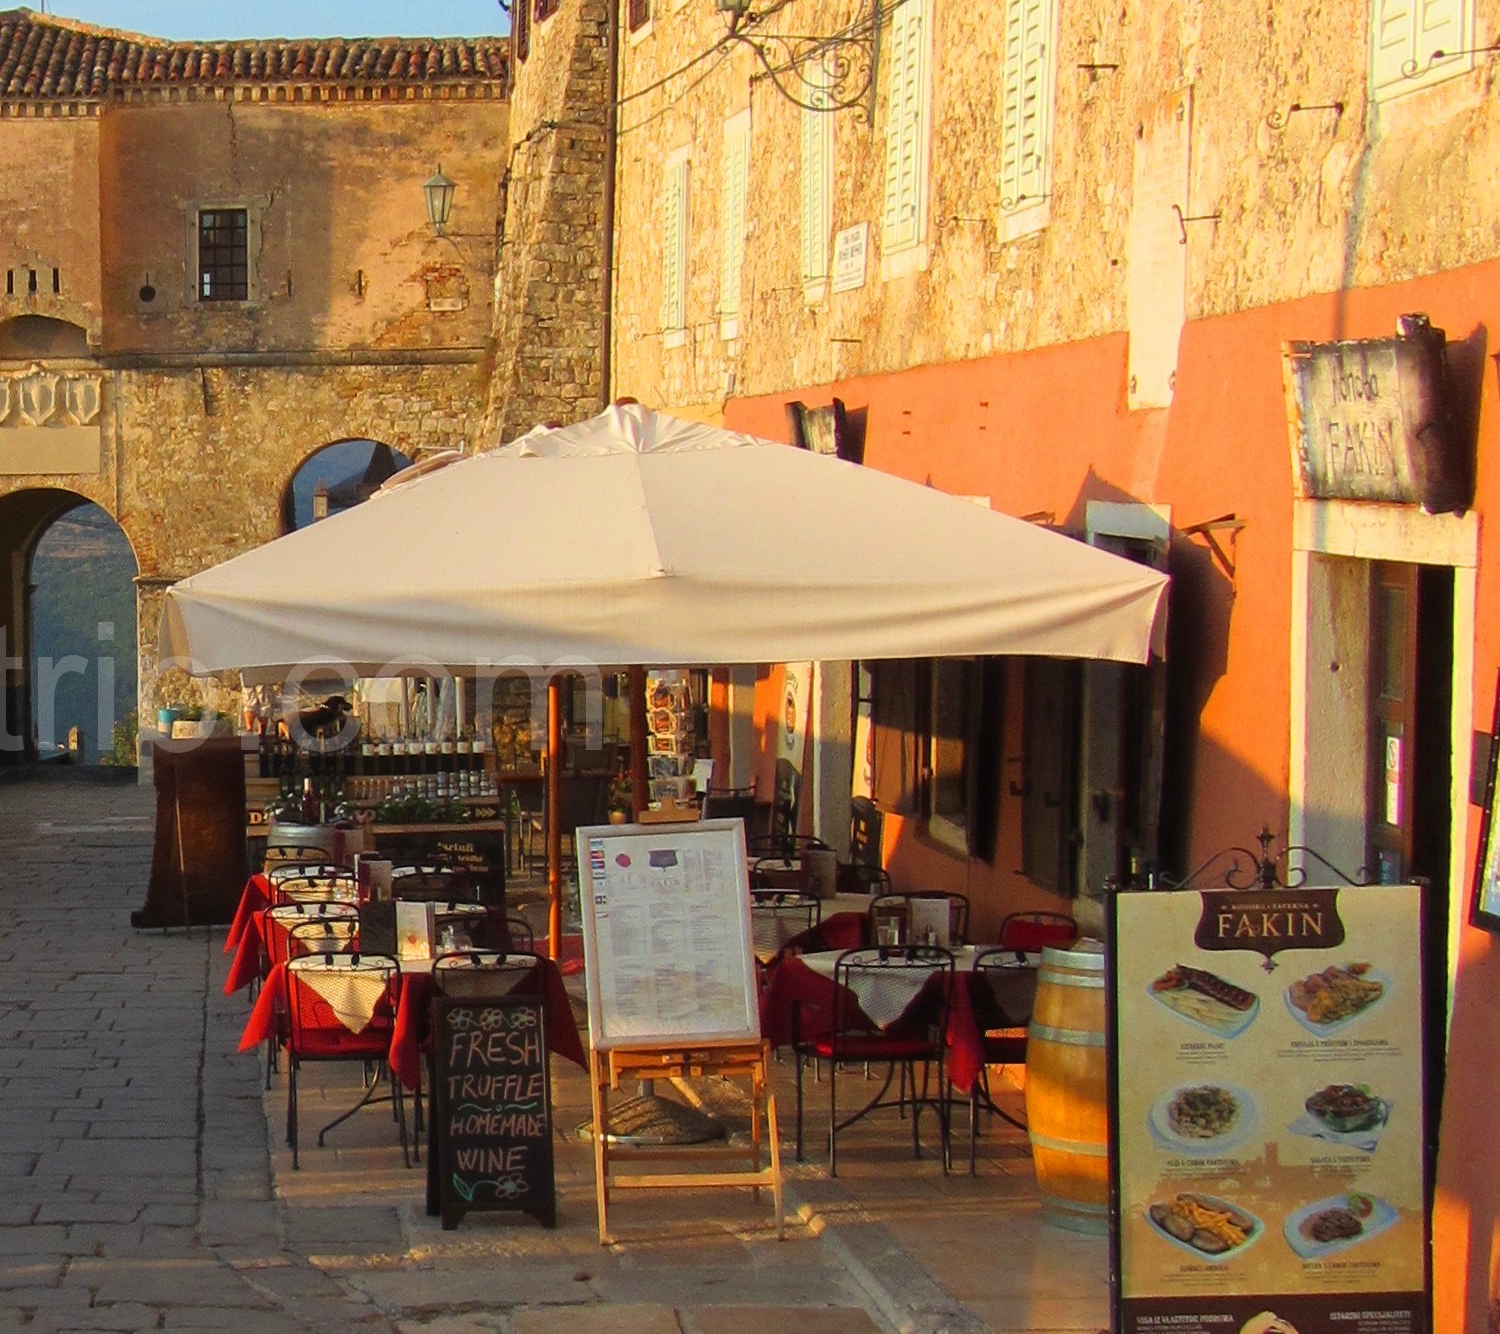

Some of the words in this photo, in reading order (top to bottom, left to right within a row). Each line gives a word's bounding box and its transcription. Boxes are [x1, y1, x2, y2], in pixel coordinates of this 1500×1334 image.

[1328, 420, 1398, 484] FAKIN
[1217, 912, 1322, 938] FAKIN
[449, 1031, 540, 1067] FRESH
[448, 1072, 543, 1102] TRUFFLE
[451, 1113, 545, 1137] HOMEMADE
[457, 1146, 528, 1173] WINE
